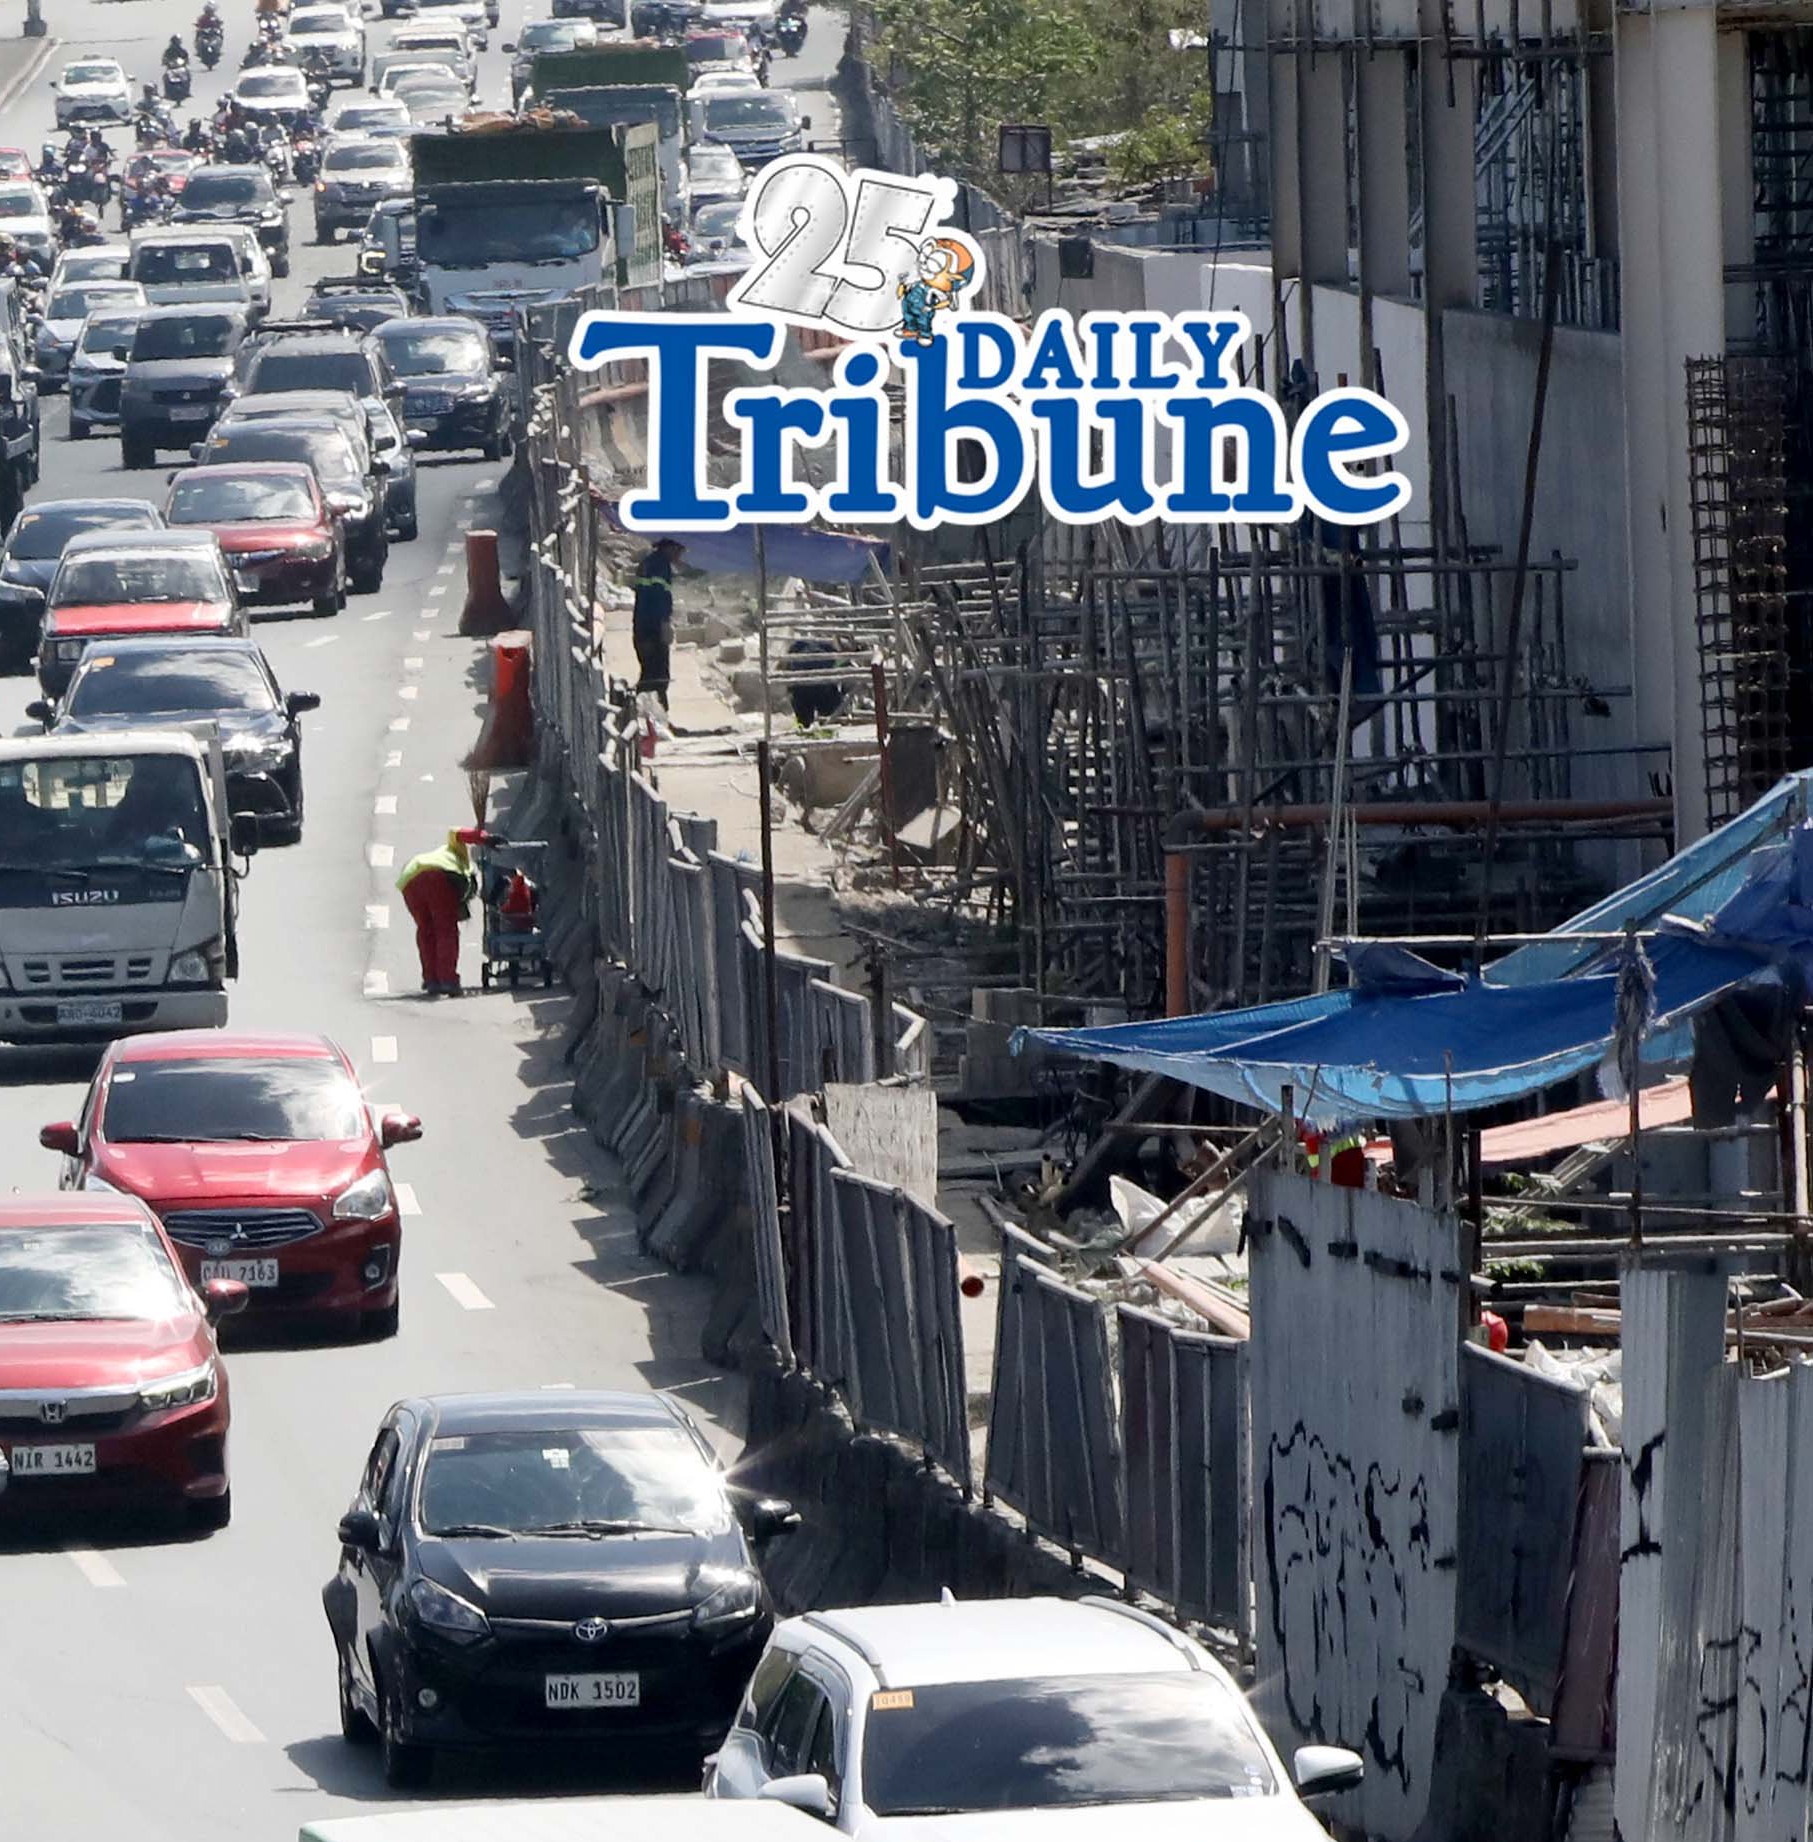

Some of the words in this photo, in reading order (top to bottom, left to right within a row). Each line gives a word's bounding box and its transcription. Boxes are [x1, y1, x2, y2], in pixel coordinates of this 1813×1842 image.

[52, 889, 119, 905] ISUZU
[240, 1263, 275, 1281] 7163
[13, 1453, 43, 1469] NIR
[55, 1451, 94, 1468] 1442
[548, 1682, 580, 1701] NDK
[592, 1680, 637, 1699] 1502
